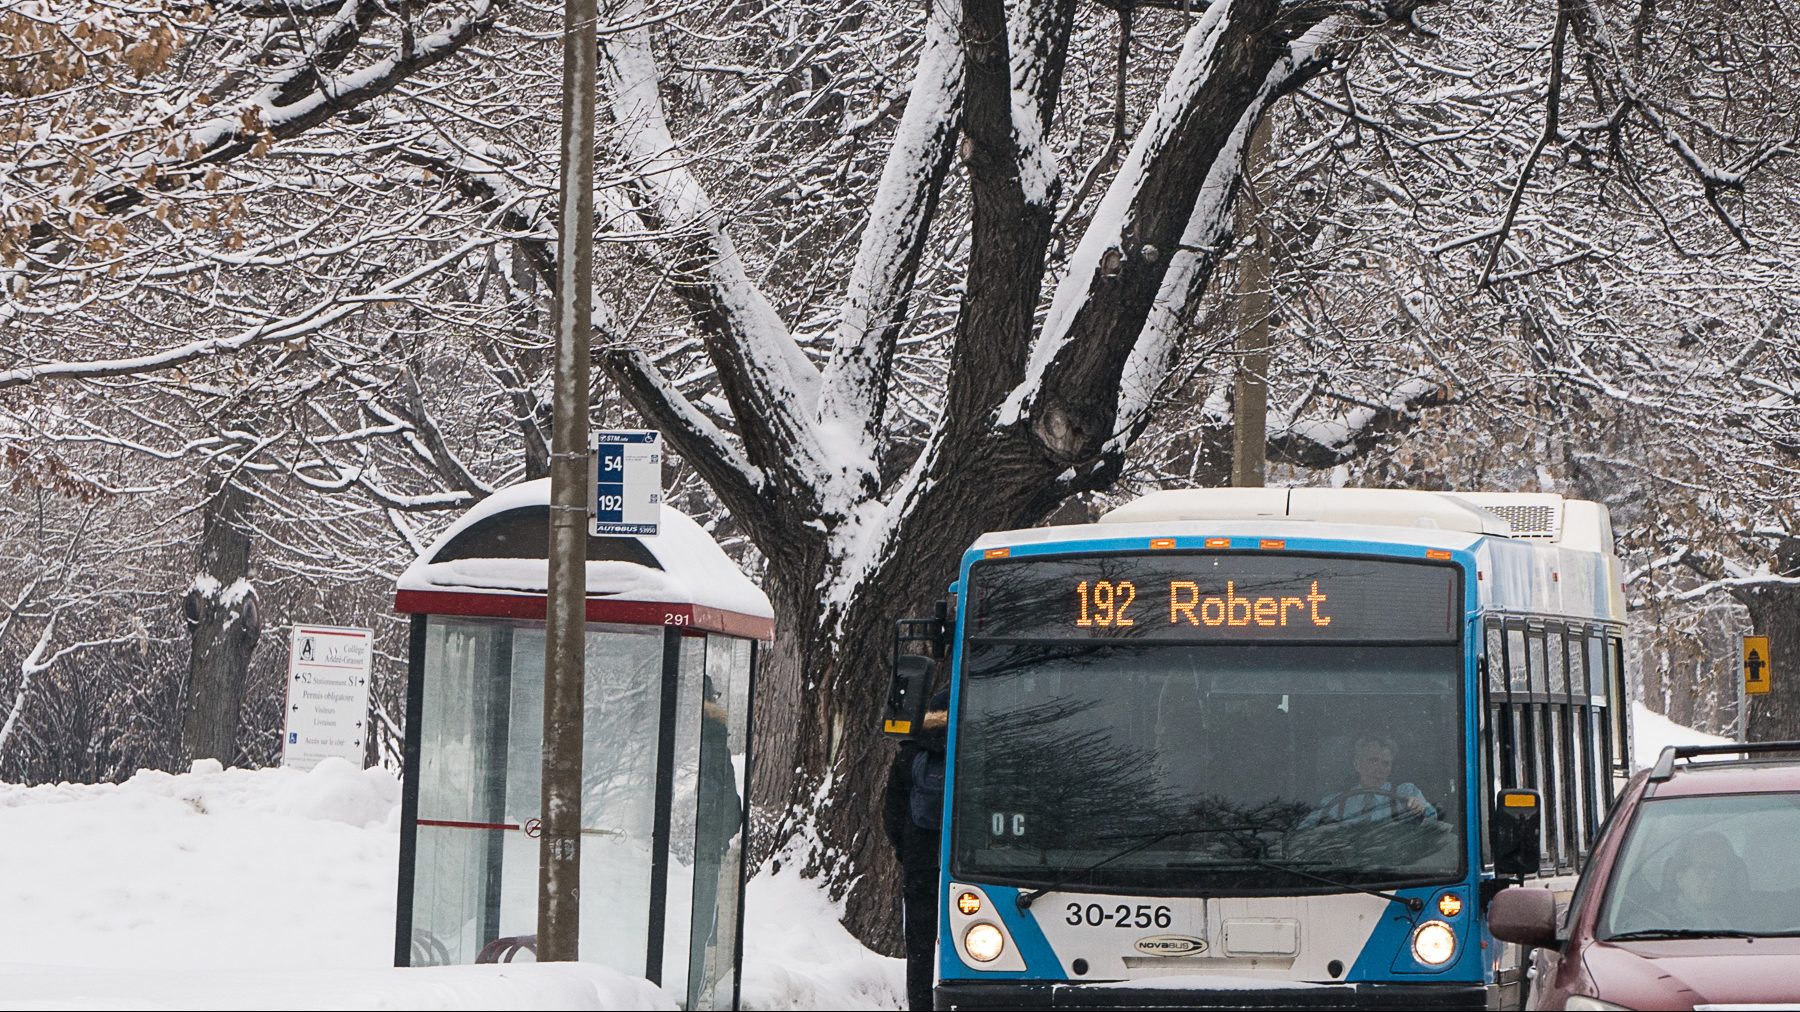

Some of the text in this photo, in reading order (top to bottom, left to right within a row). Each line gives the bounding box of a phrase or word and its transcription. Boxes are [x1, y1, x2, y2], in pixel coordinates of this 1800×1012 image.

[604, 455, 623, 472] 54
[598, 495, 622, 511] 192
[1076, 580, 1332, 627] 192 Robert
[664, 613, 689, 626] 291
[301, 672, 312, 684] S2
[348, 675, 358, 687] S1
[302, 690, 355, 702] Permis obligatoire
[1065, 902, 1172, 929] 30-256
